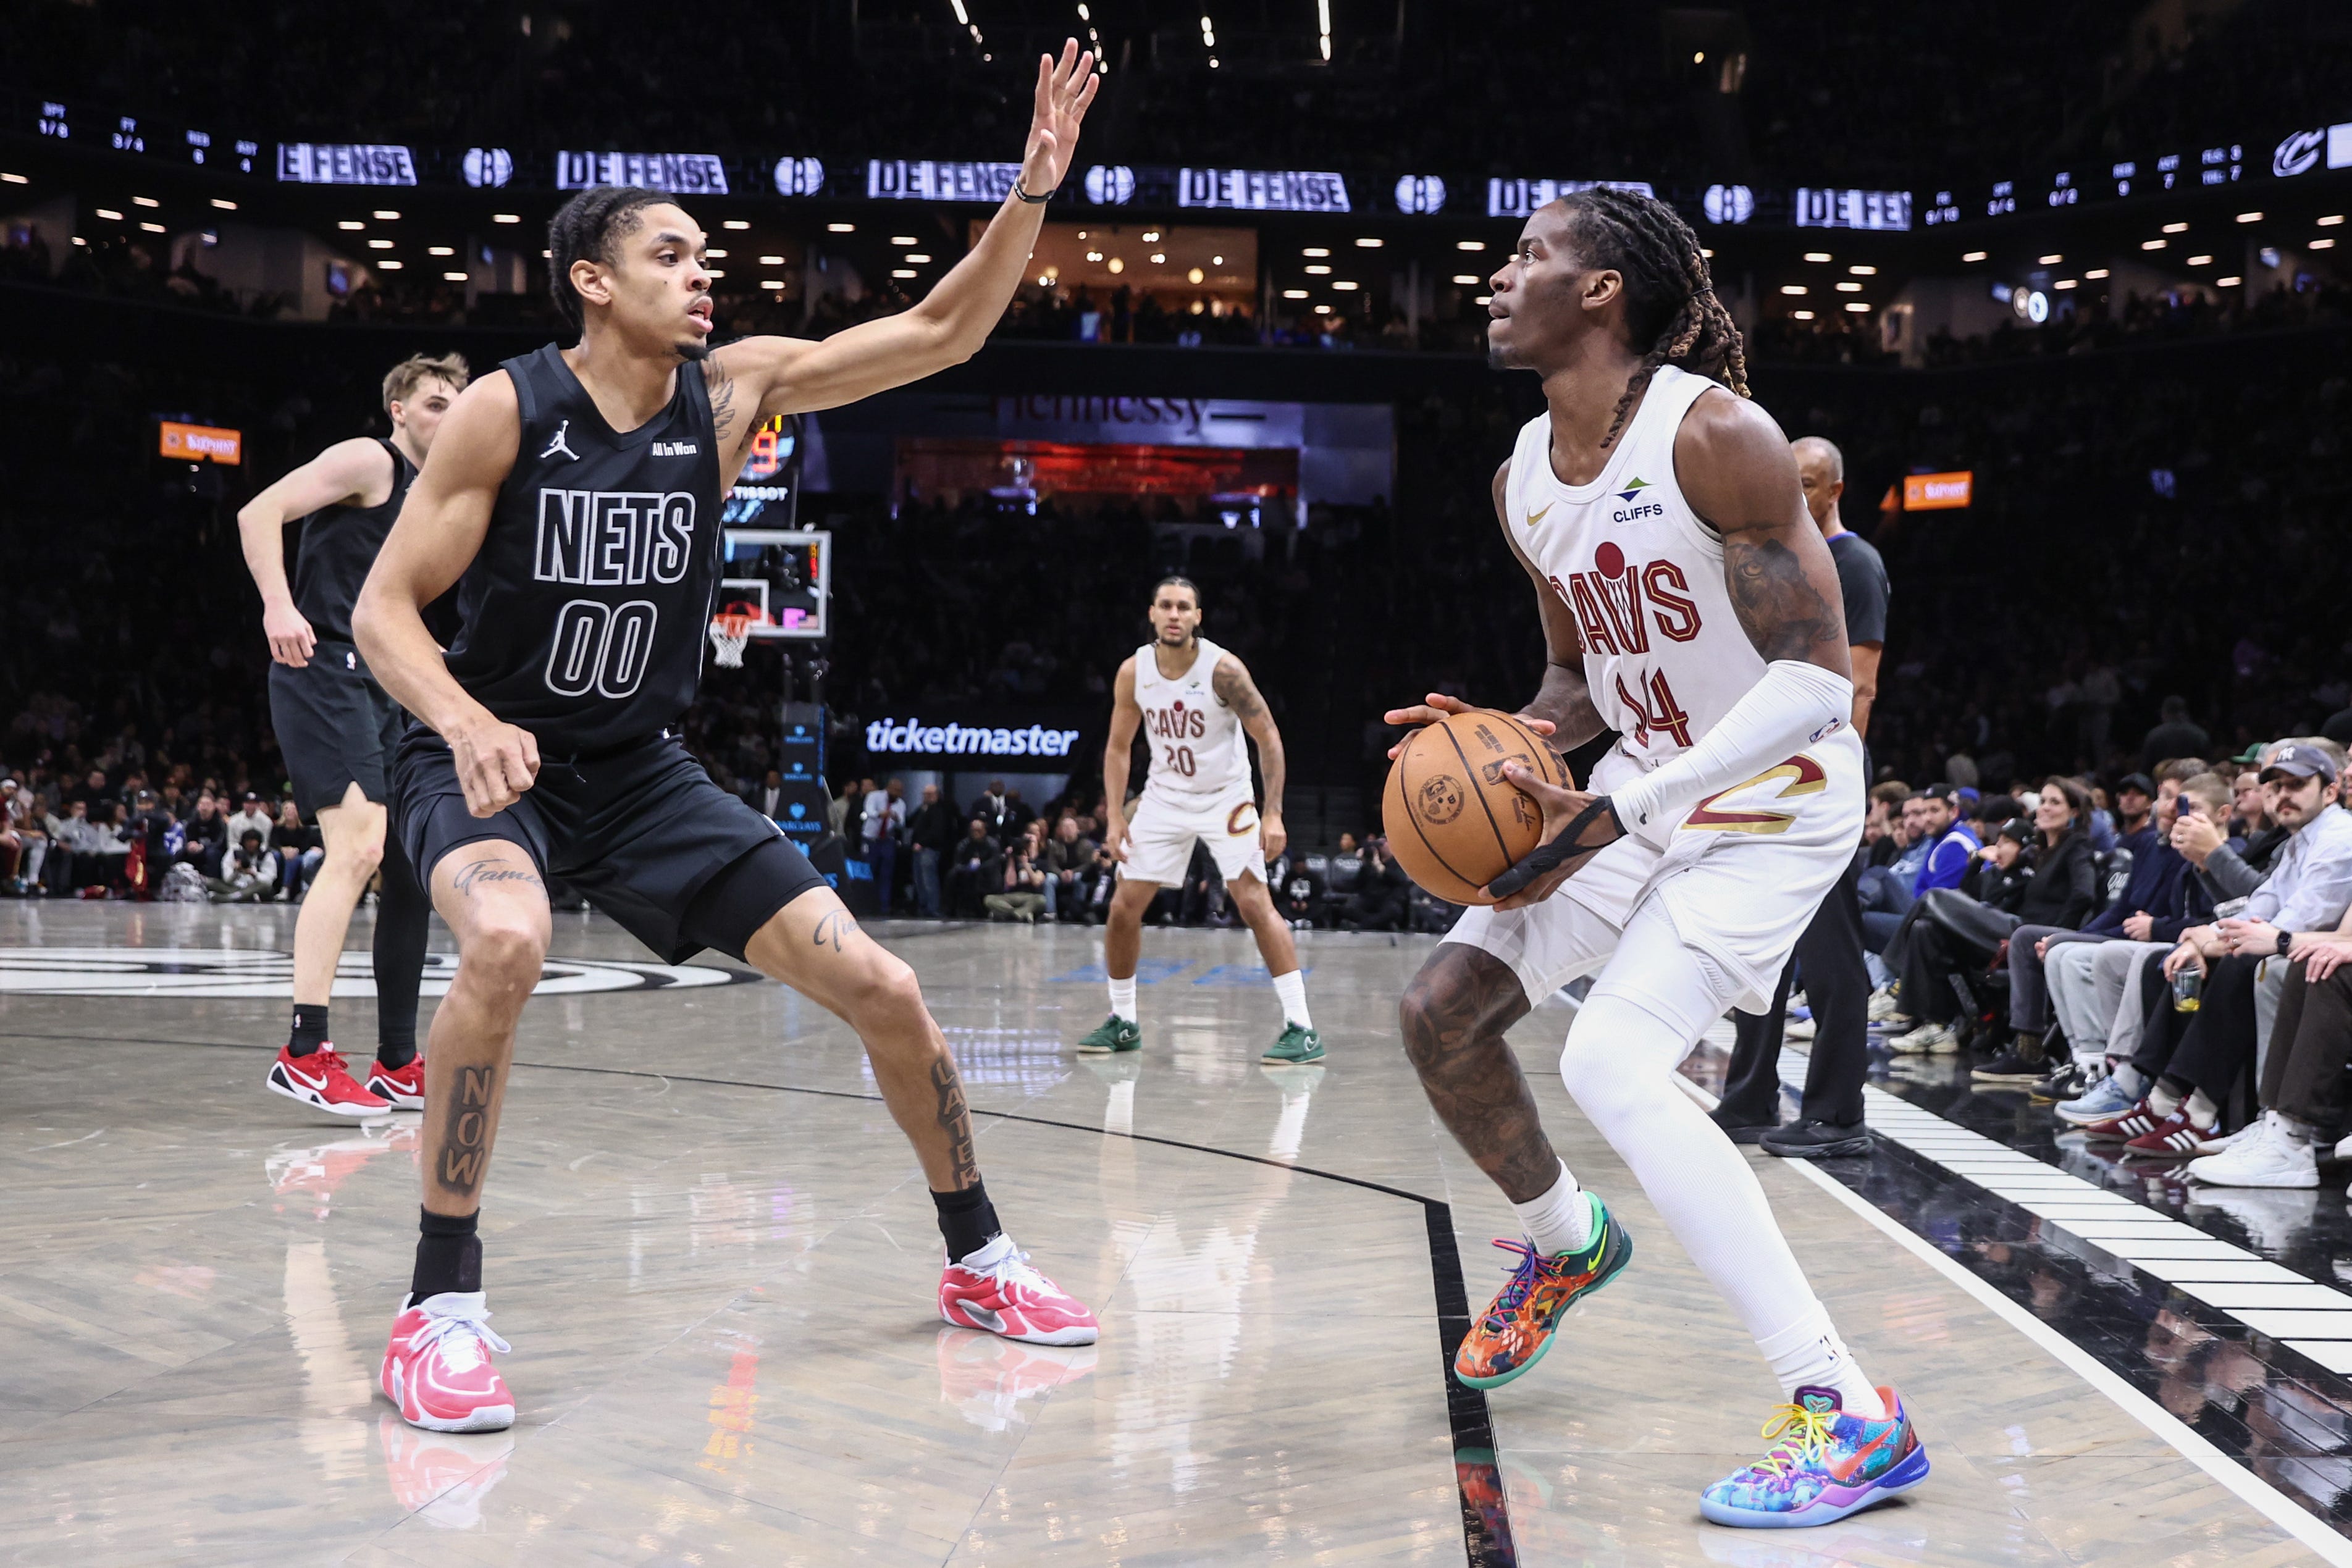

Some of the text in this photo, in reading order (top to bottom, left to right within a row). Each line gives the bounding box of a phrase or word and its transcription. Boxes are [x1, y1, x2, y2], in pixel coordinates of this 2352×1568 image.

[279, 143, 415, 185] EFENSE
[558, 150, 729, 195] DEFENSE
[868, 159, 1023, 202] DEFENS
[1178, 168, 1351, 212] DEFENSE
[653, 442, 697, 456] All In Won
[733, 486, 788, 501] TISSOT
[1613, 504, 1663, 522] CLIFFS
[534, 488, 696, 585] NETS
[545, 599, 657, 698] 00
[1145, 707, 1205, 739] CAVS
[1616, 666, 1694, 748] 14
[867, 718, 1080, 756] ticketmaster
[1165, 744, 1196, 777] 20
[445, 1066, 494, 1187] NOW
